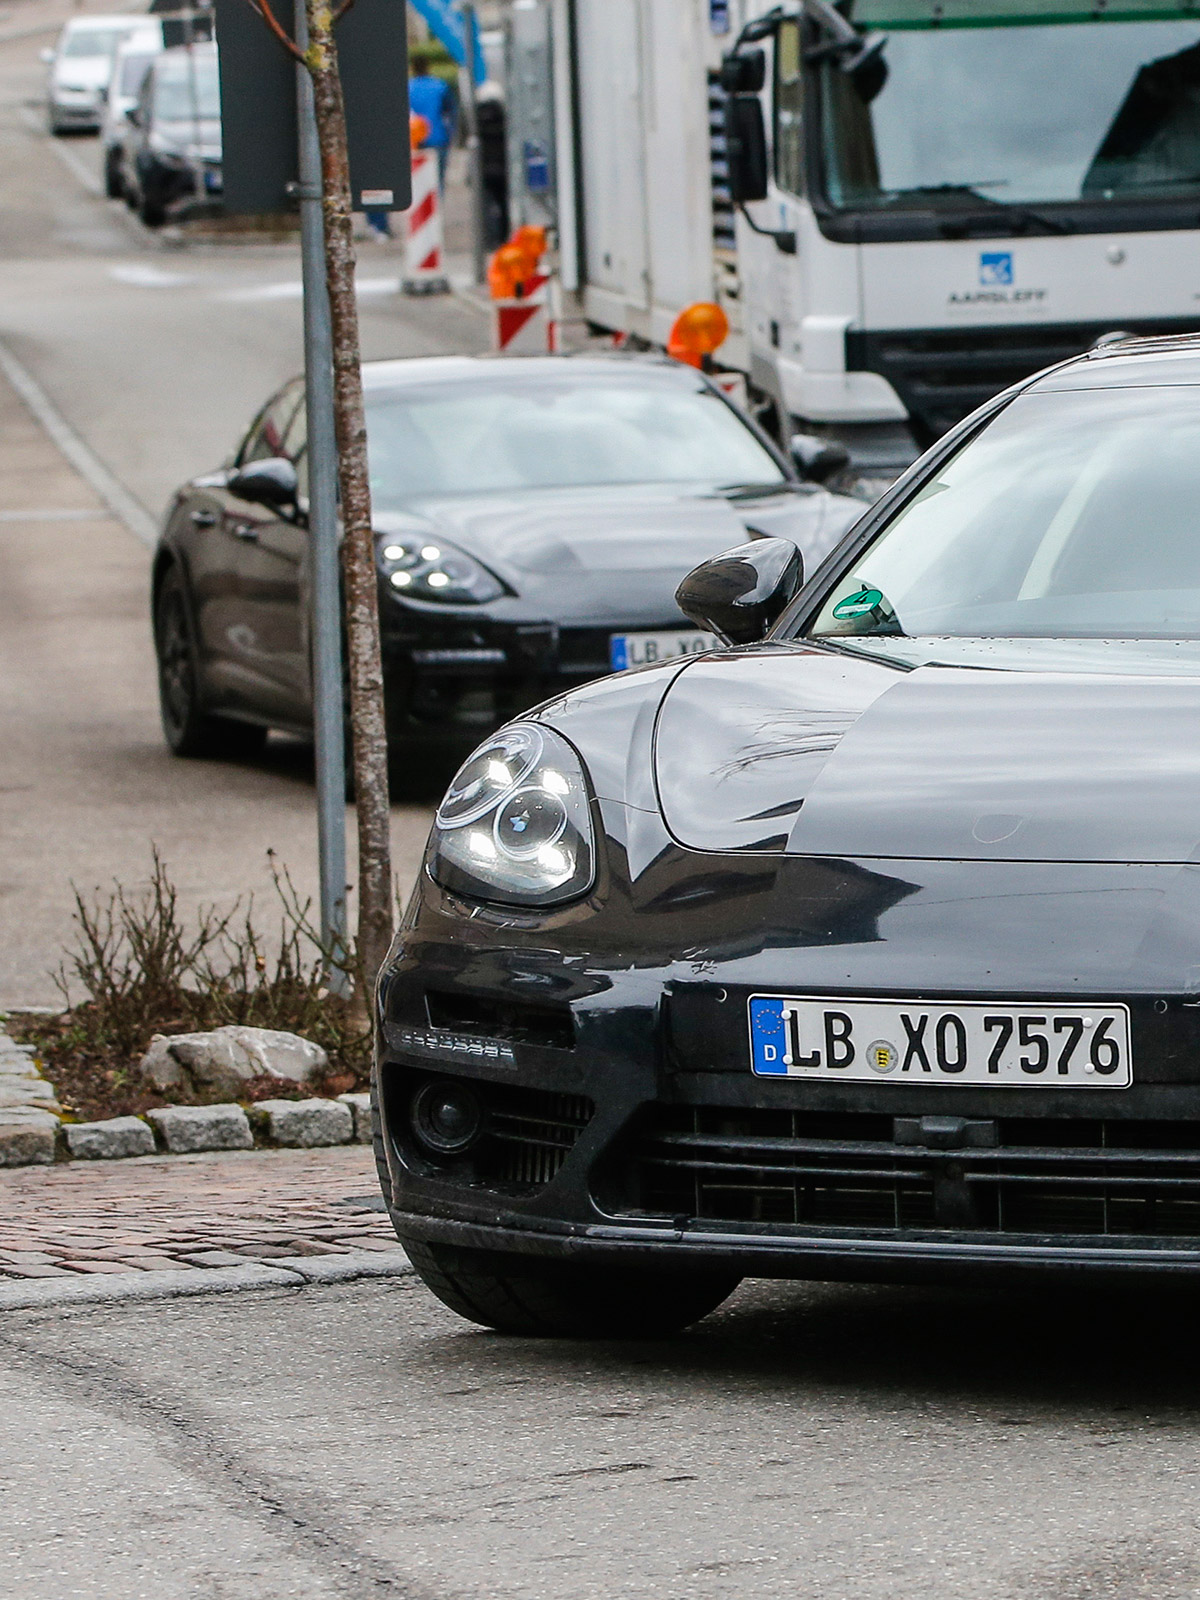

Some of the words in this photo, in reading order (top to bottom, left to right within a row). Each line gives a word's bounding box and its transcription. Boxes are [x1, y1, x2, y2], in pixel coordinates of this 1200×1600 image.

[630, 640, 658, 664] LB
[764, 1044, 777, 1061] D
[789, 1009, 856, 1069] LB
[900, 1013, 967, 1074] XO
[983, 1016, 1120, 1075] 7576
